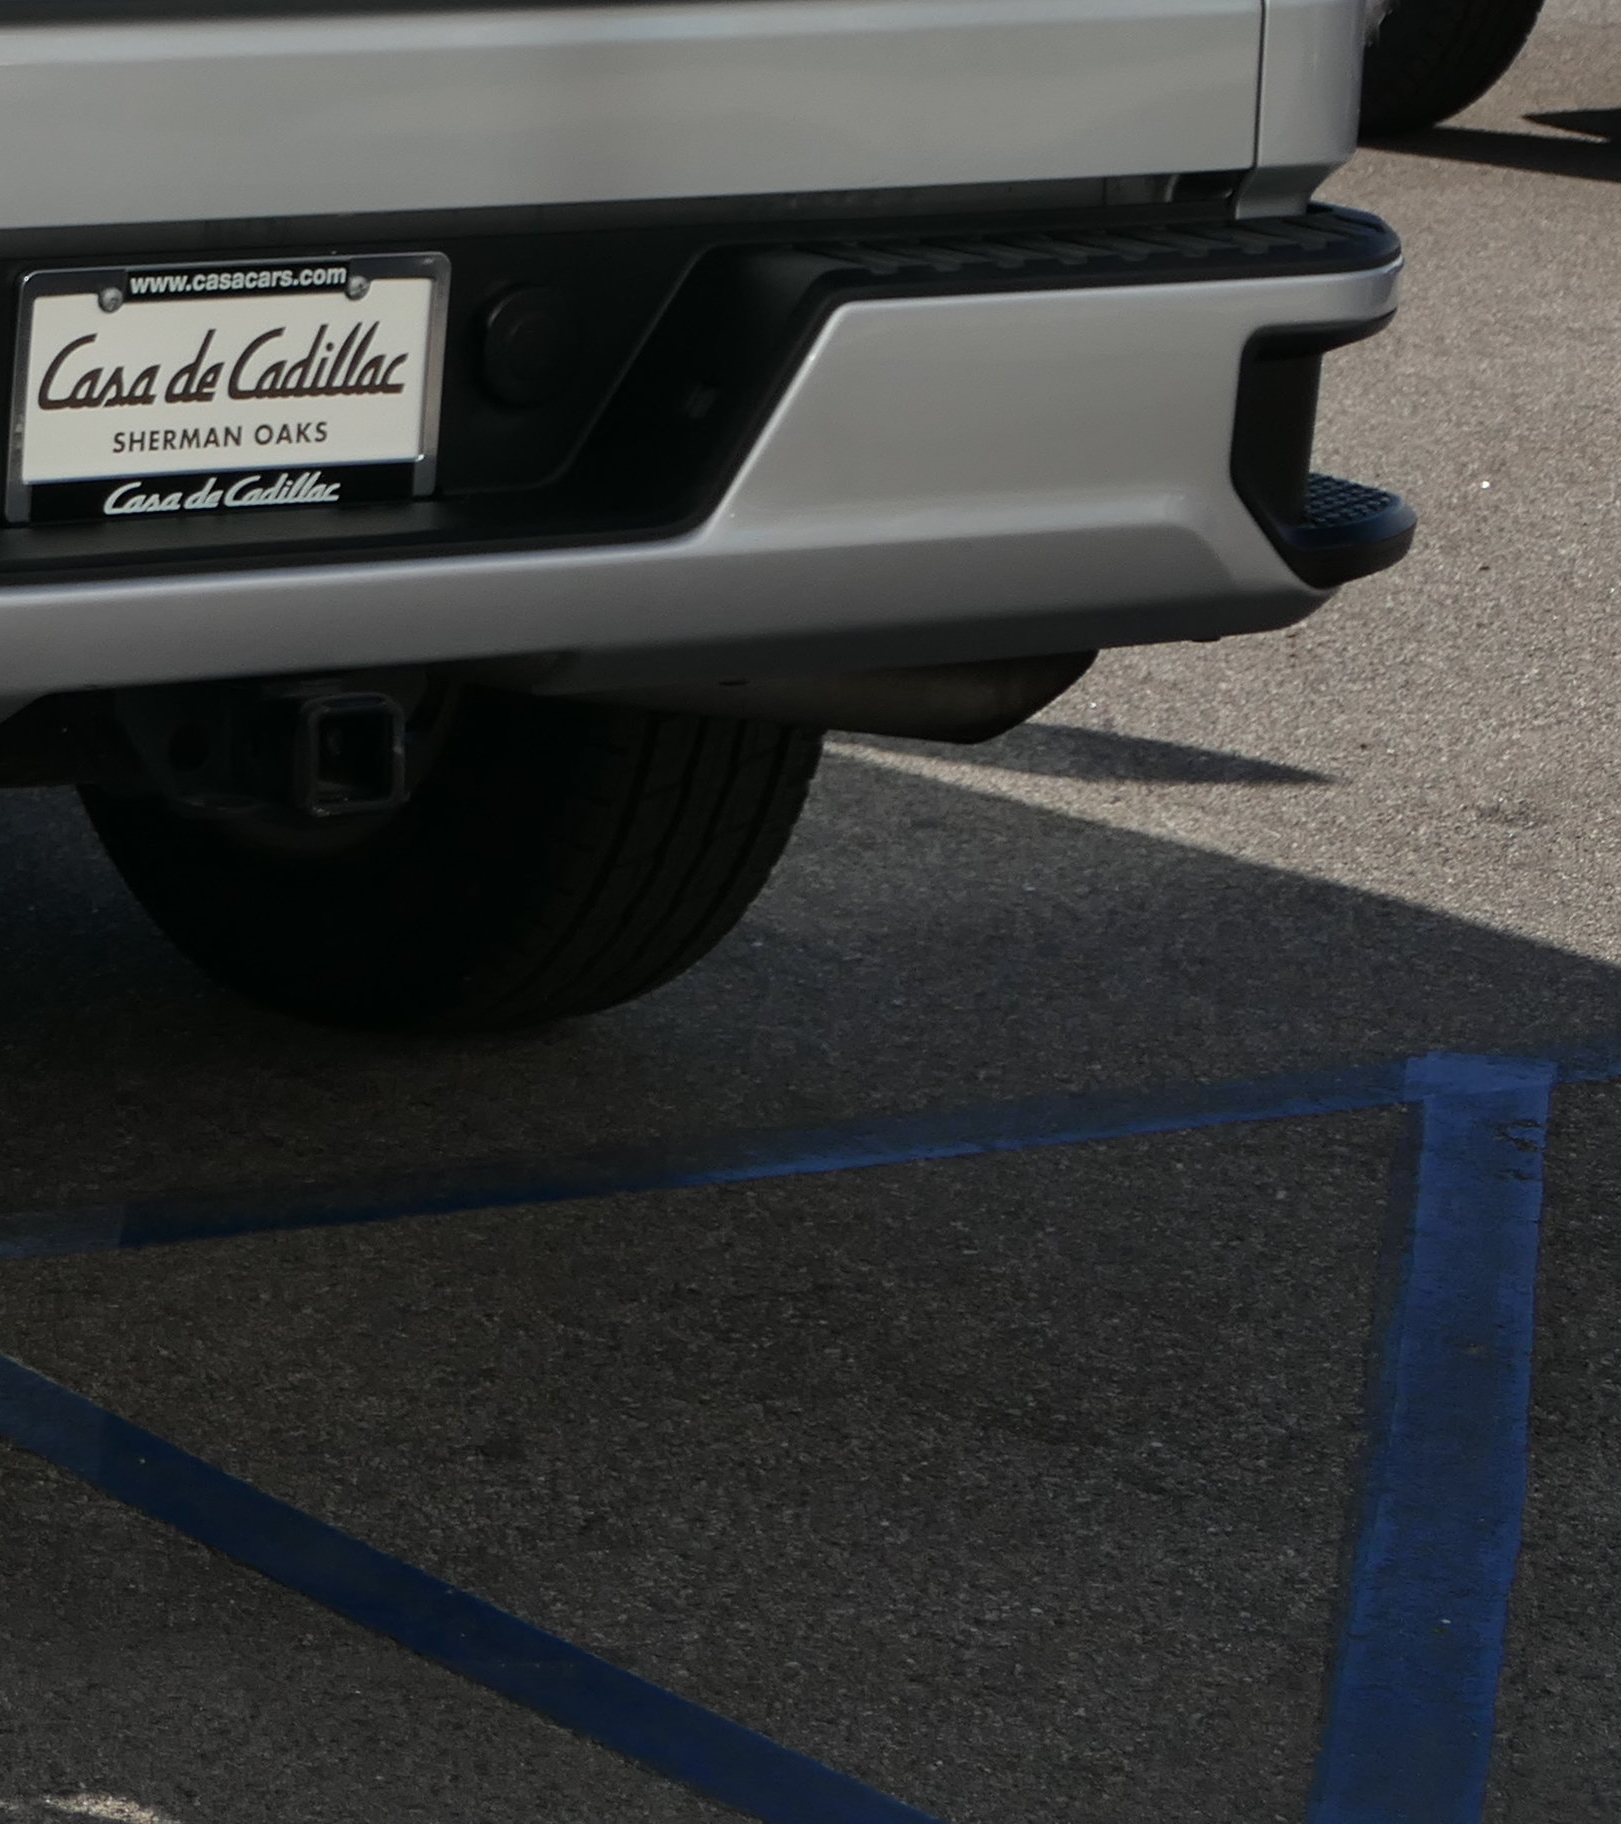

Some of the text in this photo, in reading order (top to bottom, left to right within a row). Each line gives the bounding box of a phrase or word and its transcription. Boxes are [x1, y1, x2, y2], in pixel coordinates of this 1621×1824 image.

[129, 266, 347, 295] www.casacars.com
[37, 320, 410, 411] Casa de Cadillac
[111, 421, 329, 454] SHERMAN OAKS
[103, 471, 342, 517] Casa de Cadillac
